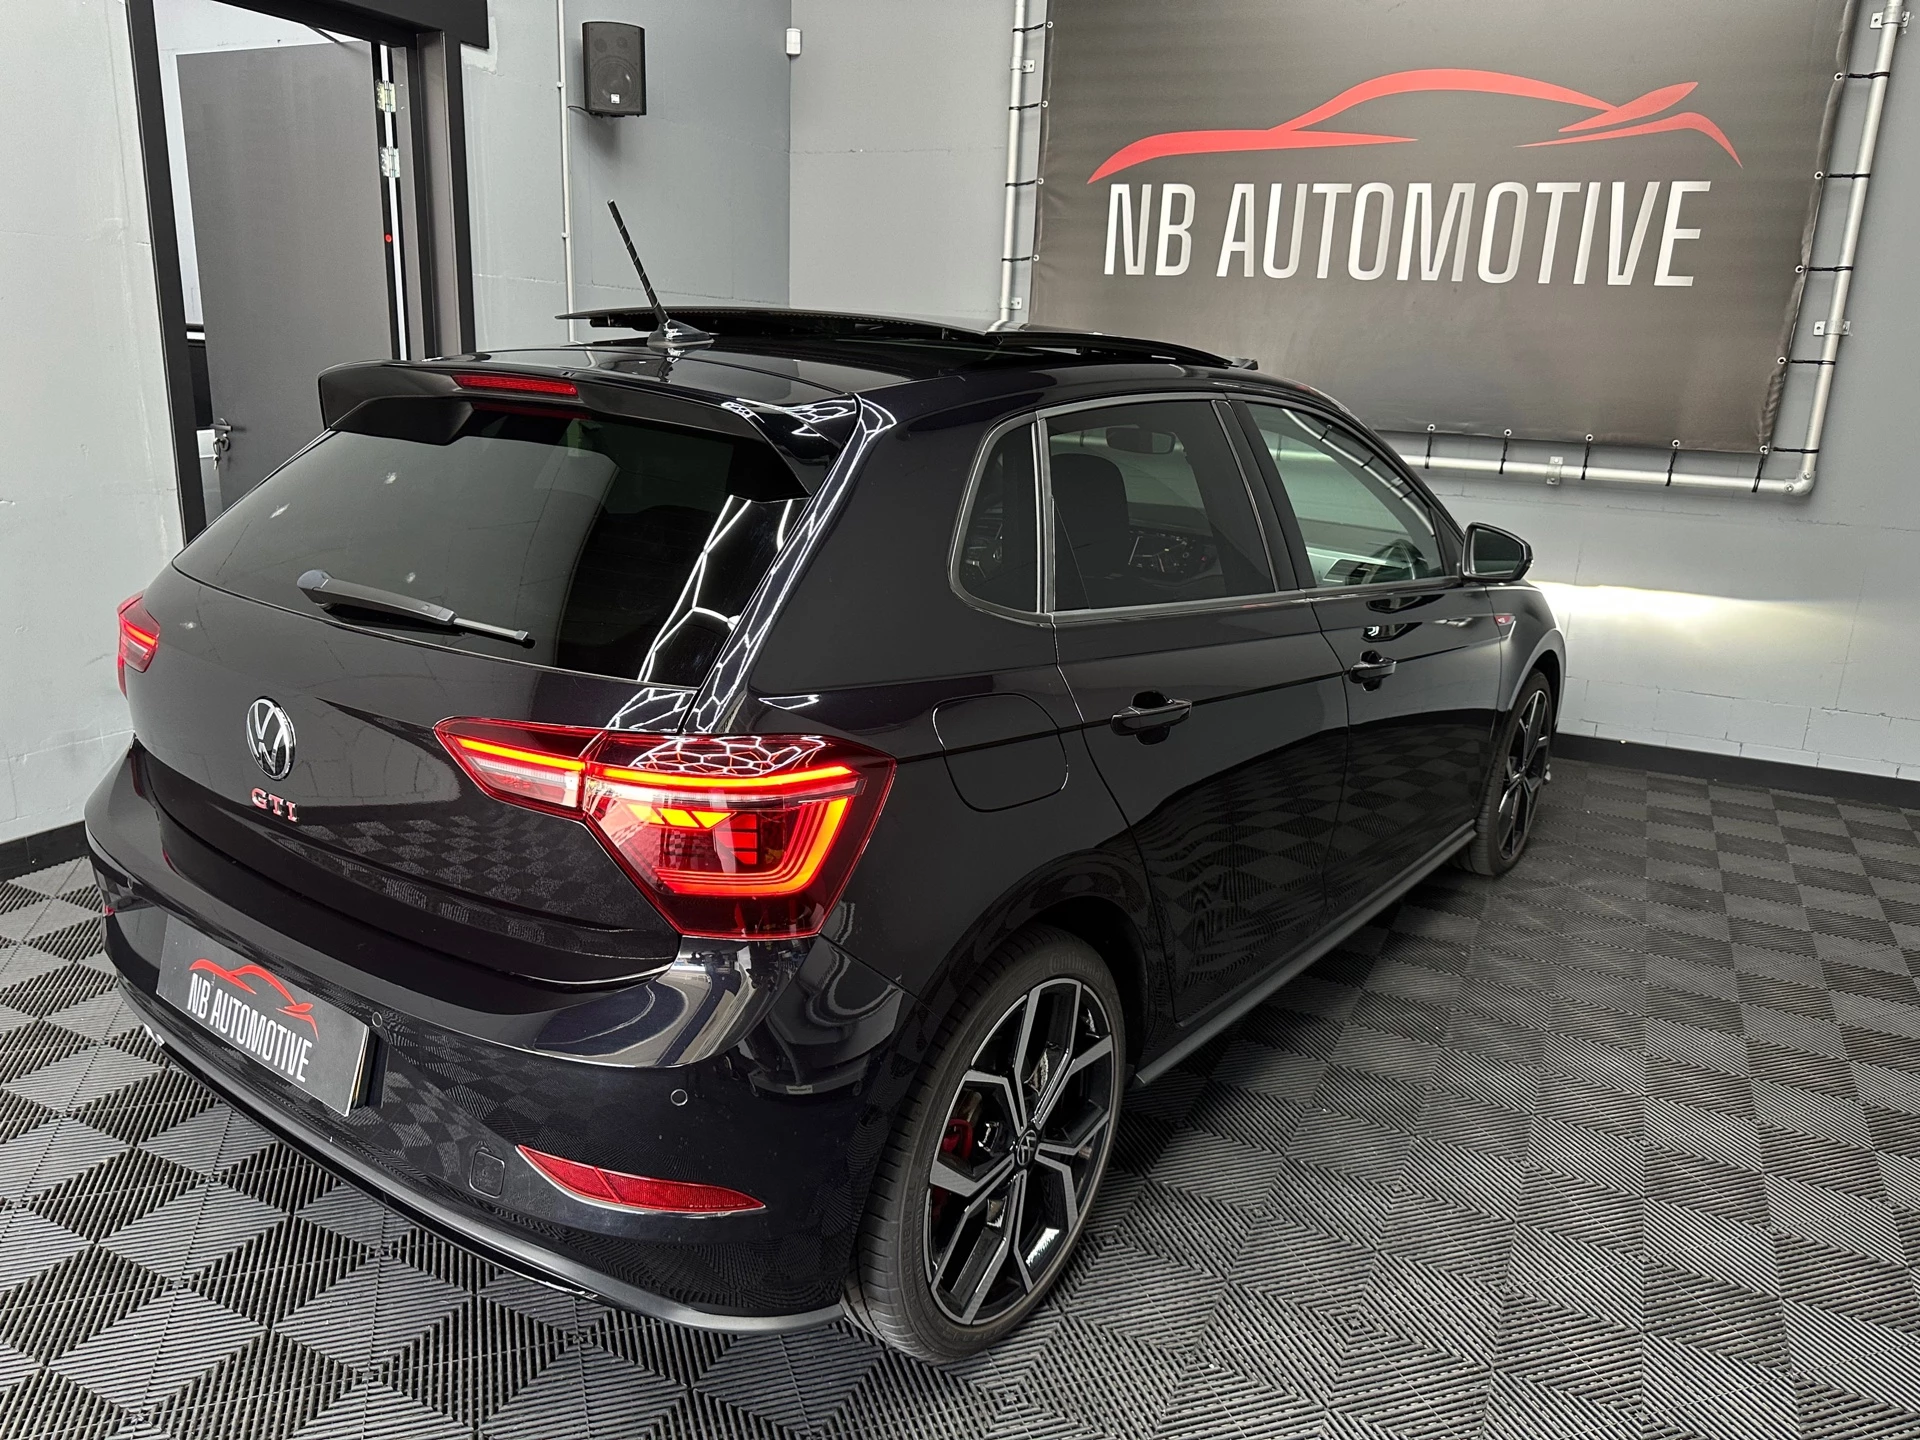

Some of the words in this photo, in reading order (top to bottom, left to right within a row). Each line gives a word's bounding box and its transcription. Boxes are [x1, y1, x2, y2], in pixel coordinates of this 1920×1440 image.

[1103, 183, 1196, 276] NB
[1215, 180, 1711, 287] AUTOMOTIVE
[251, 787, 298, 822] GTI
[187, 972, 211, 1020] NB
[209, 988, 313, 1083] AUTOMOTIVE
